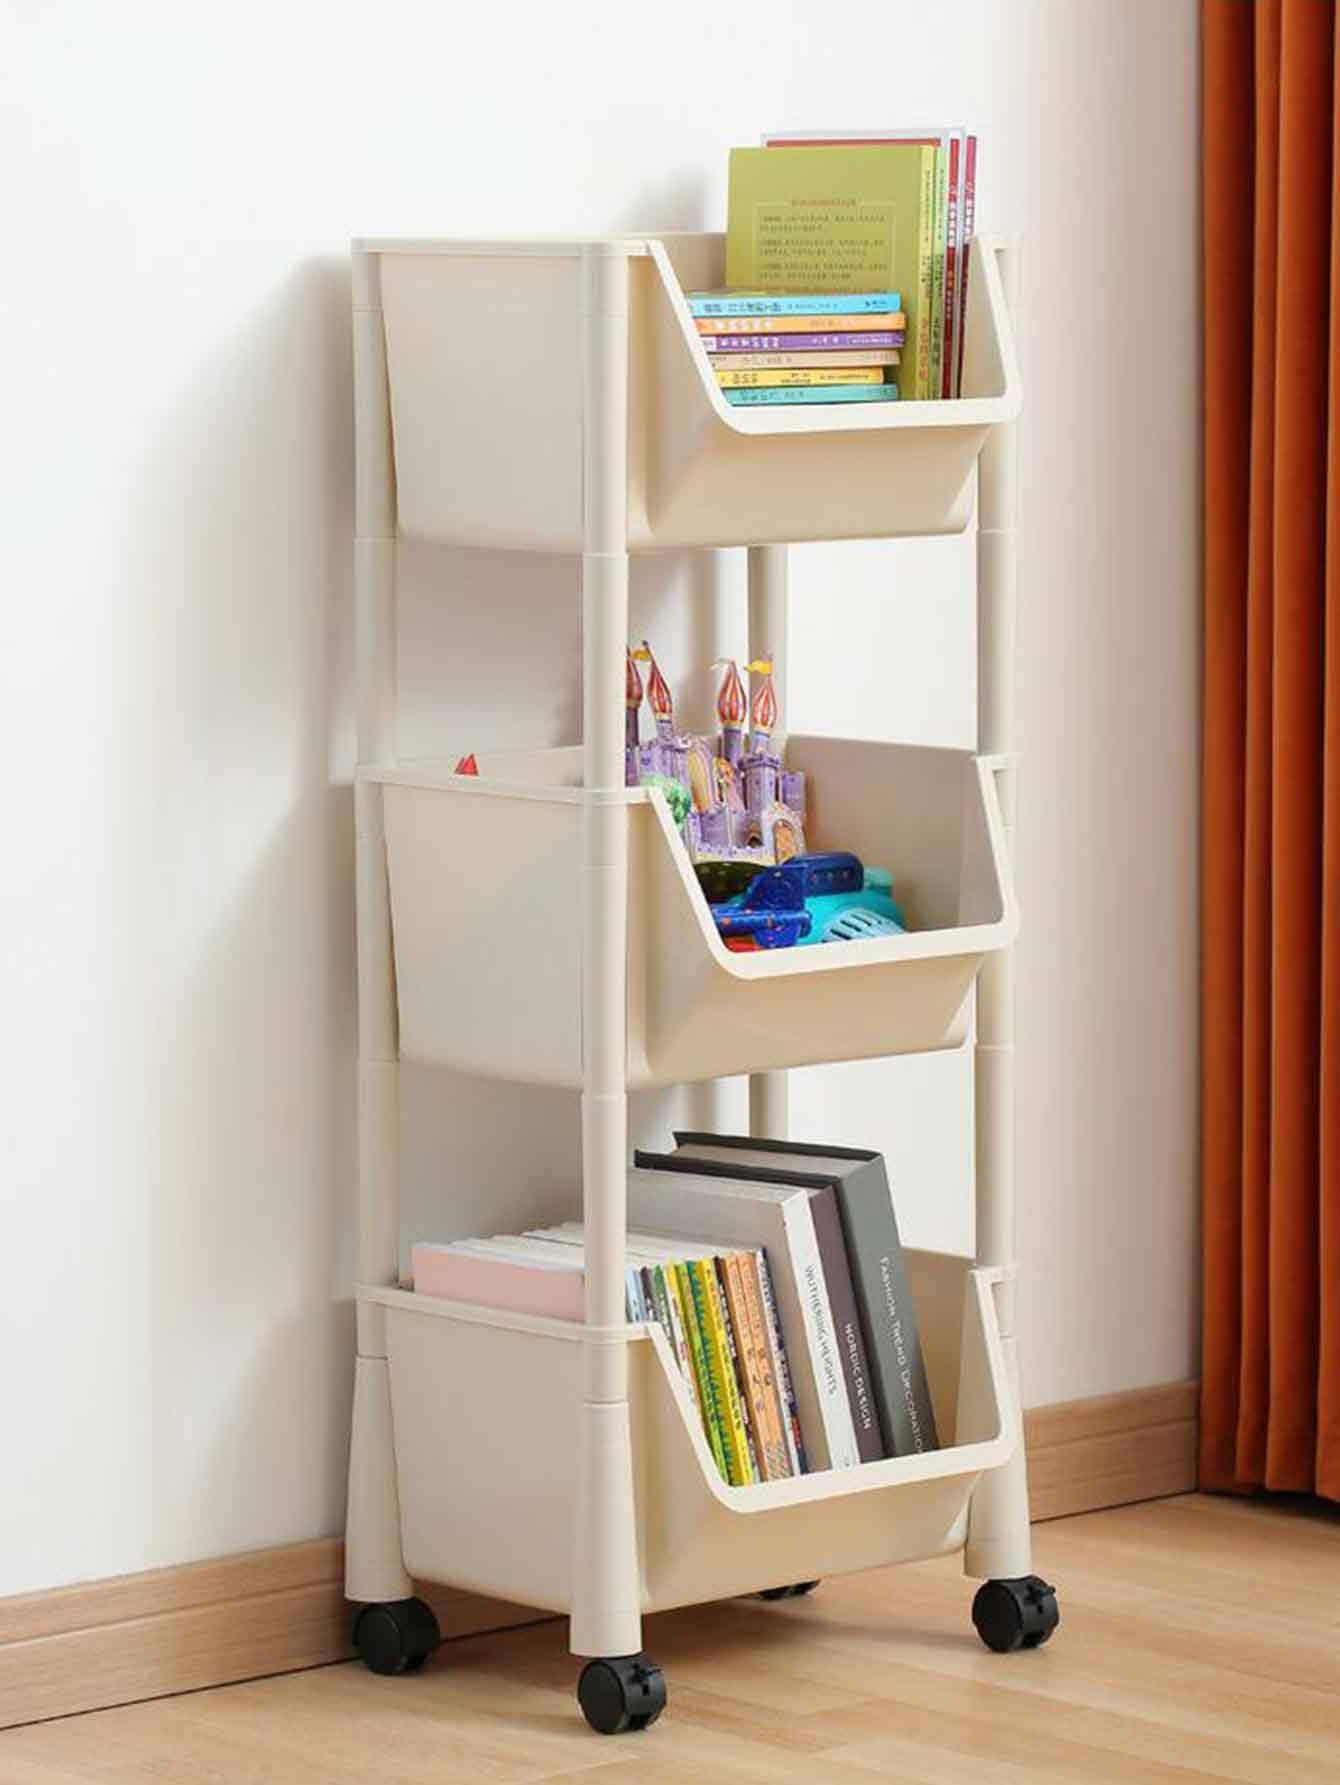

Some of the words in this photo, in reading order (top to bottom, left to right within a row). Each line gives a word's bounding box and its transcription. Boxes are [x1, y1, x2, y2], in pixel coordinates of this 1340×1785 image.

[805, 1264, 828, 1342] WUTHERING
[820, 1343, 838, 1395] HEIGHTS
[845, 1322, 863, 1376] NORDIC
[855, 1377, 872, 1430] DESIGN
